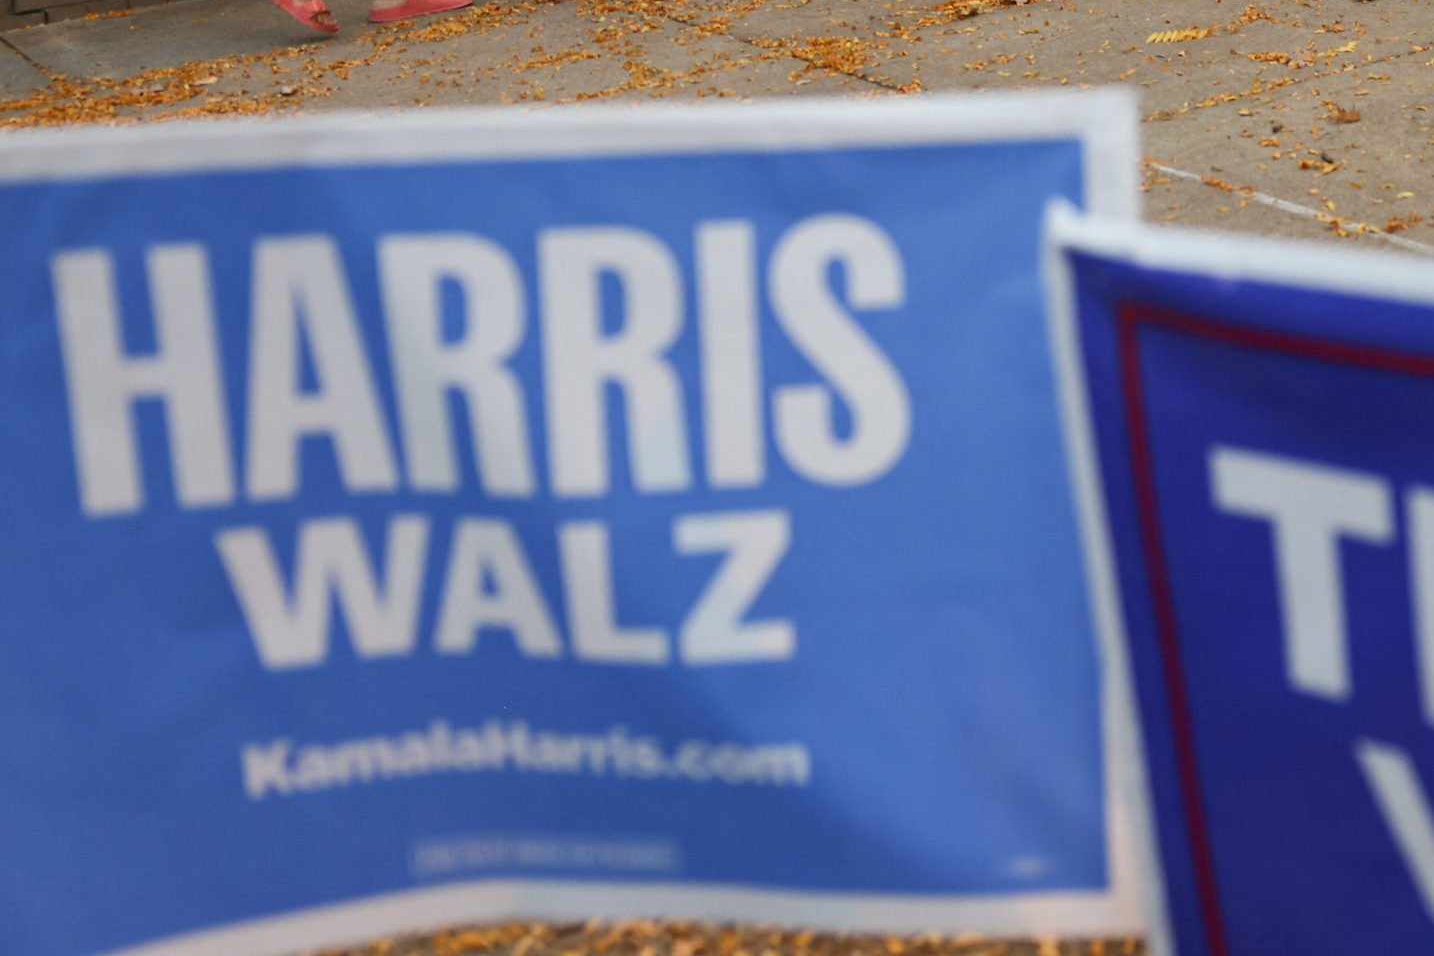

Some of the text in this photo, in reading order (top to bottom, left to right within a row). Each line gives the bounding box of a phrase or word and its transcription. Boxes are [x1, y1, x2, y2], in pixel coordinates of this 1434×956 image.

[48, 211, 916, 520] HARRIS
[214, 505, 798, 672] WALZ
[241, 718, 811, 800] KamalaHarris.com
